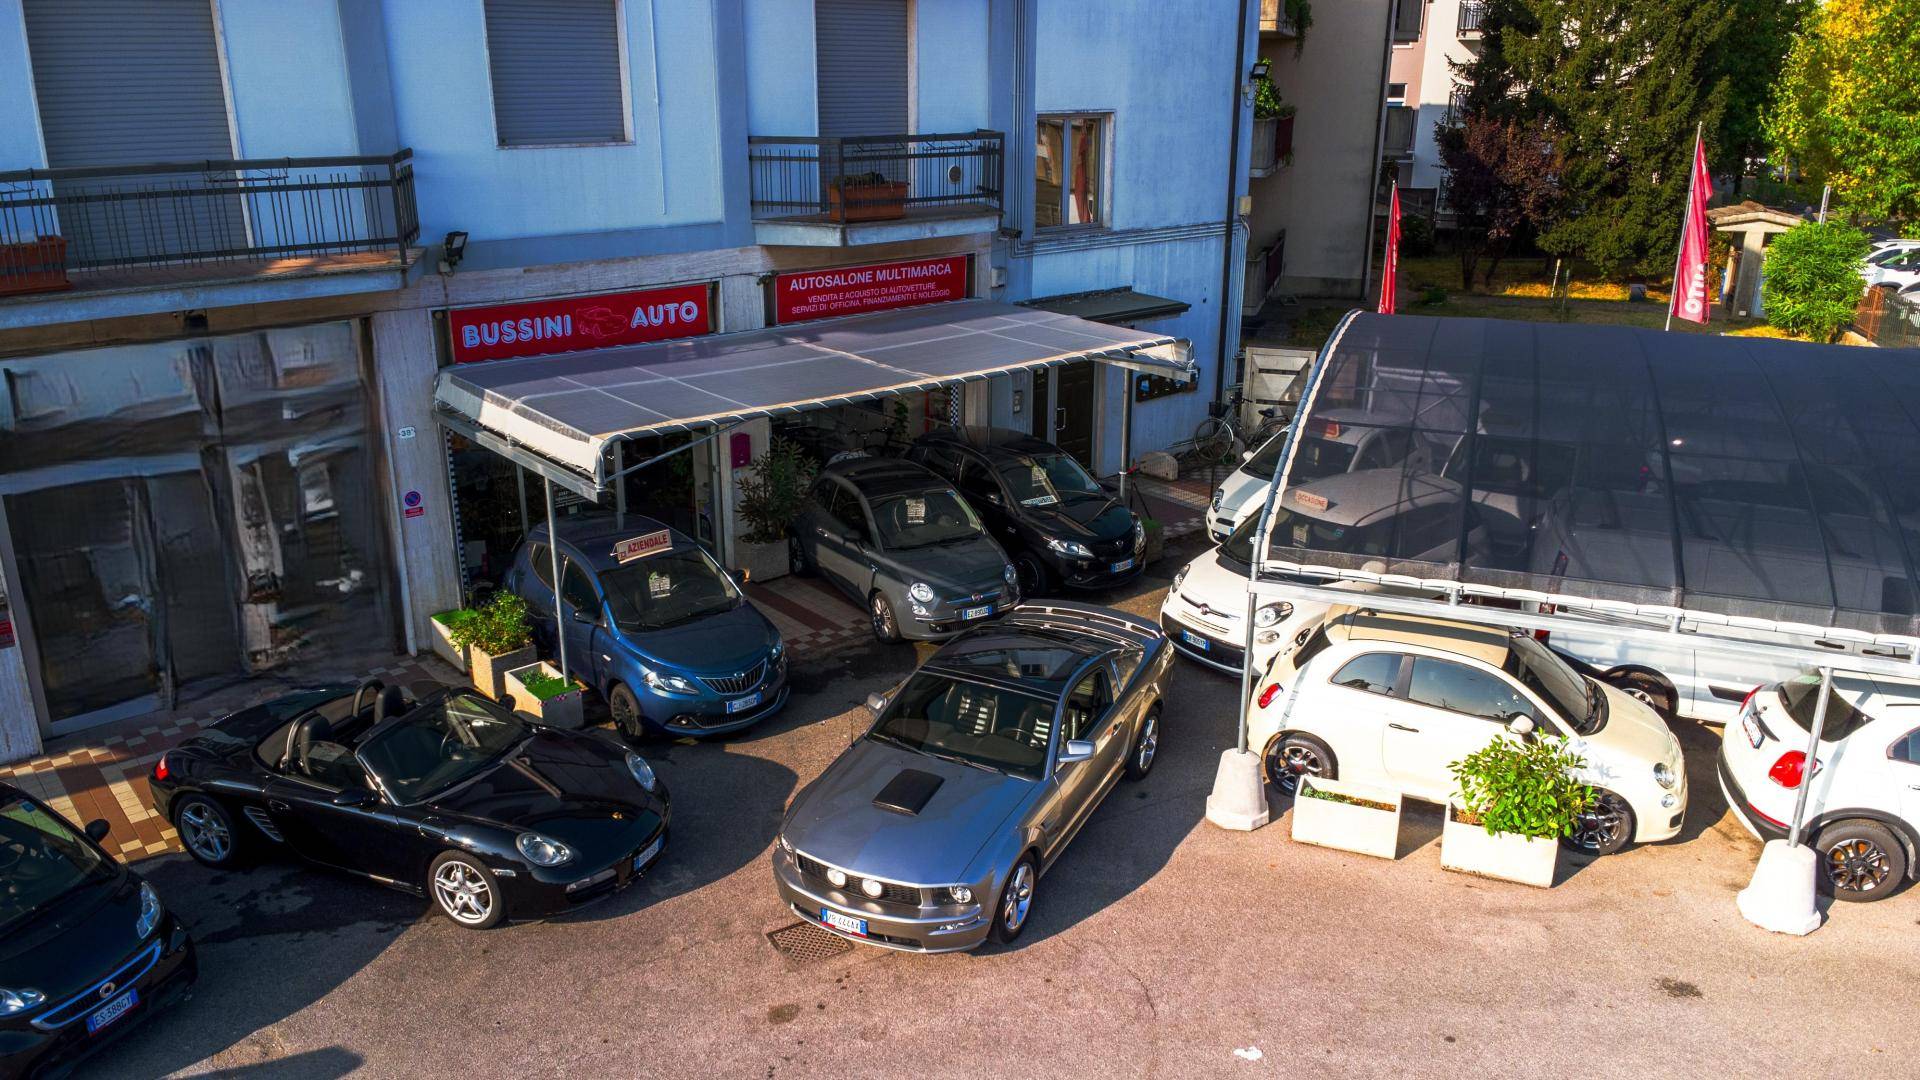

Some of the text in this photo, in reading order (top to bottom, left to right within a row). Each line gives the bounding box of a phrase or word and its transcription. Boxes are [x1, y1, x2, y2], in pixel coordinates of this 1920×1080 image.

[790, 263, 952, 291] AUTOSALONE MULTIMARCA
[791, 305, 818, 314] SERVIZI
[863, 293, 912, 305] FINANZIAMENTI
[918, 288, 951, 299] NOLEGGIO
[807, 293, 838, 303] VENDITA
[844, 288, 879, 299] ACQUISTO
[880, 287, 888, 295] DI
[888, 281, 936, 294] AUTOVETTURE
[461, 301, 699, 348] BUSSINI AUTO
[627, 534, 668, 554] AZIENDALE
